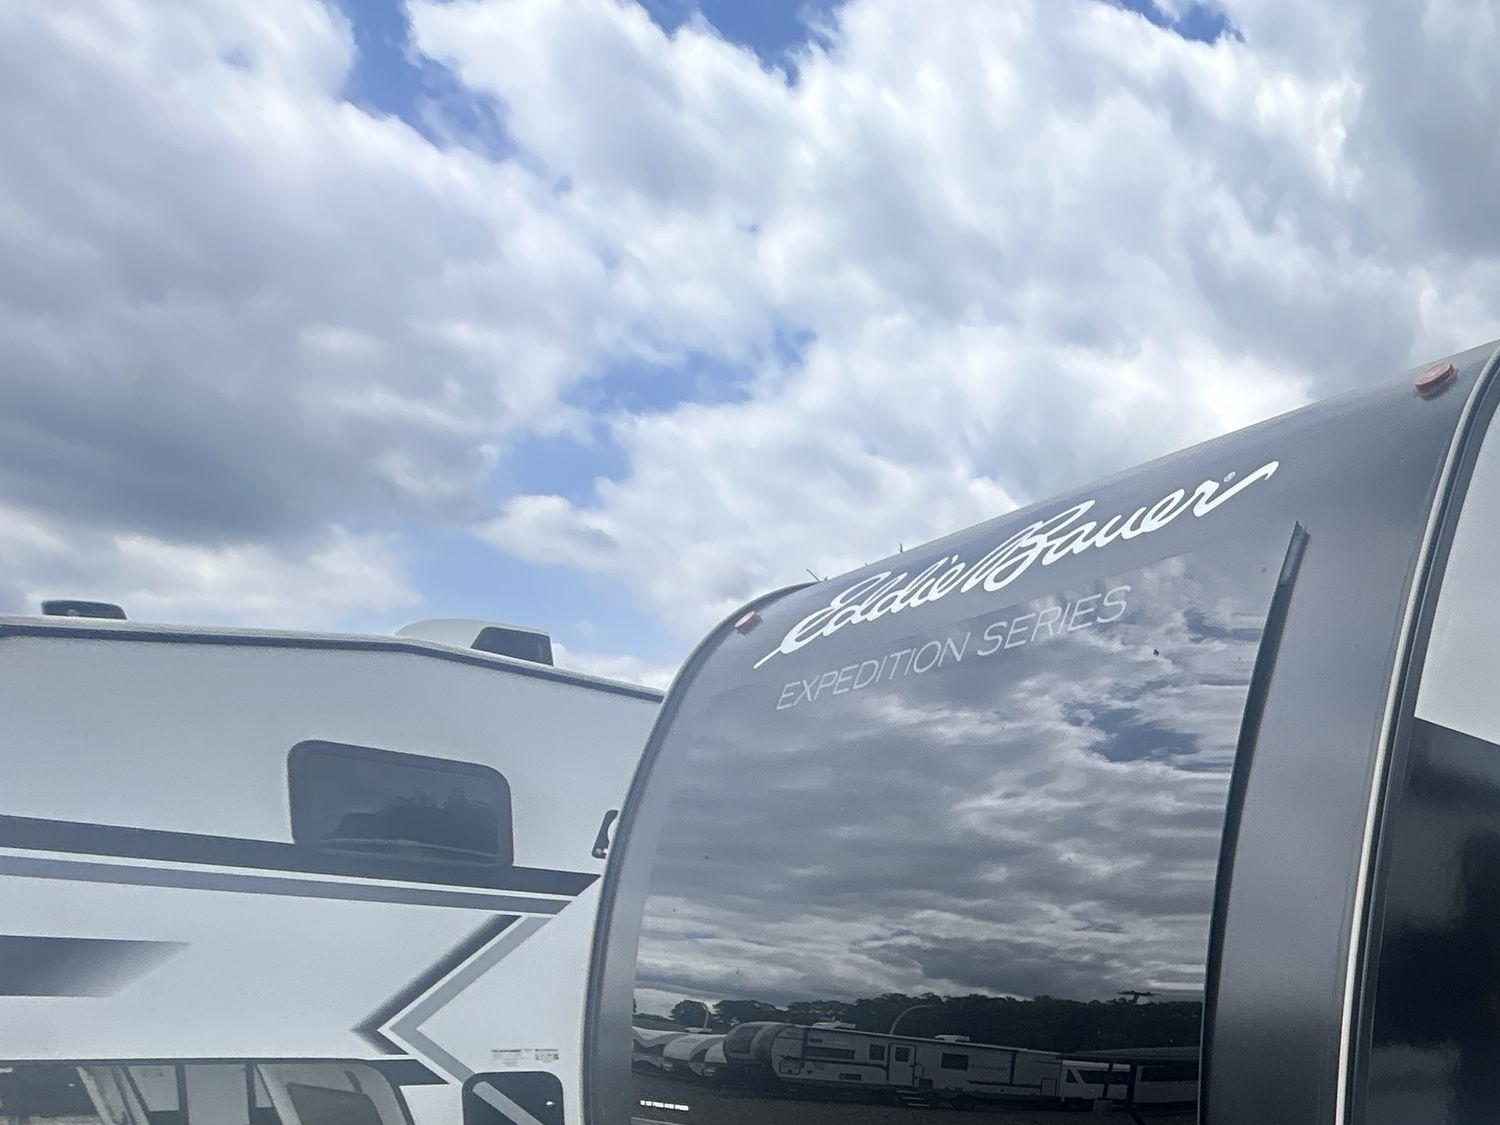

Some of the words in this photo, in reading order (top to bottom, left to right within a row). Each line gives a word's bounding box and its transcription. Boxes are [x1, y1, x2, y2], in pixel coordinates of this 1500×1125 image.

[754, 555, 965, 669] Eddie
[961, 461, 1279, 592] Bauer
[776, 631, 971, 710] EXPEDITION
[977, 586, 1131, 657] SERIES
